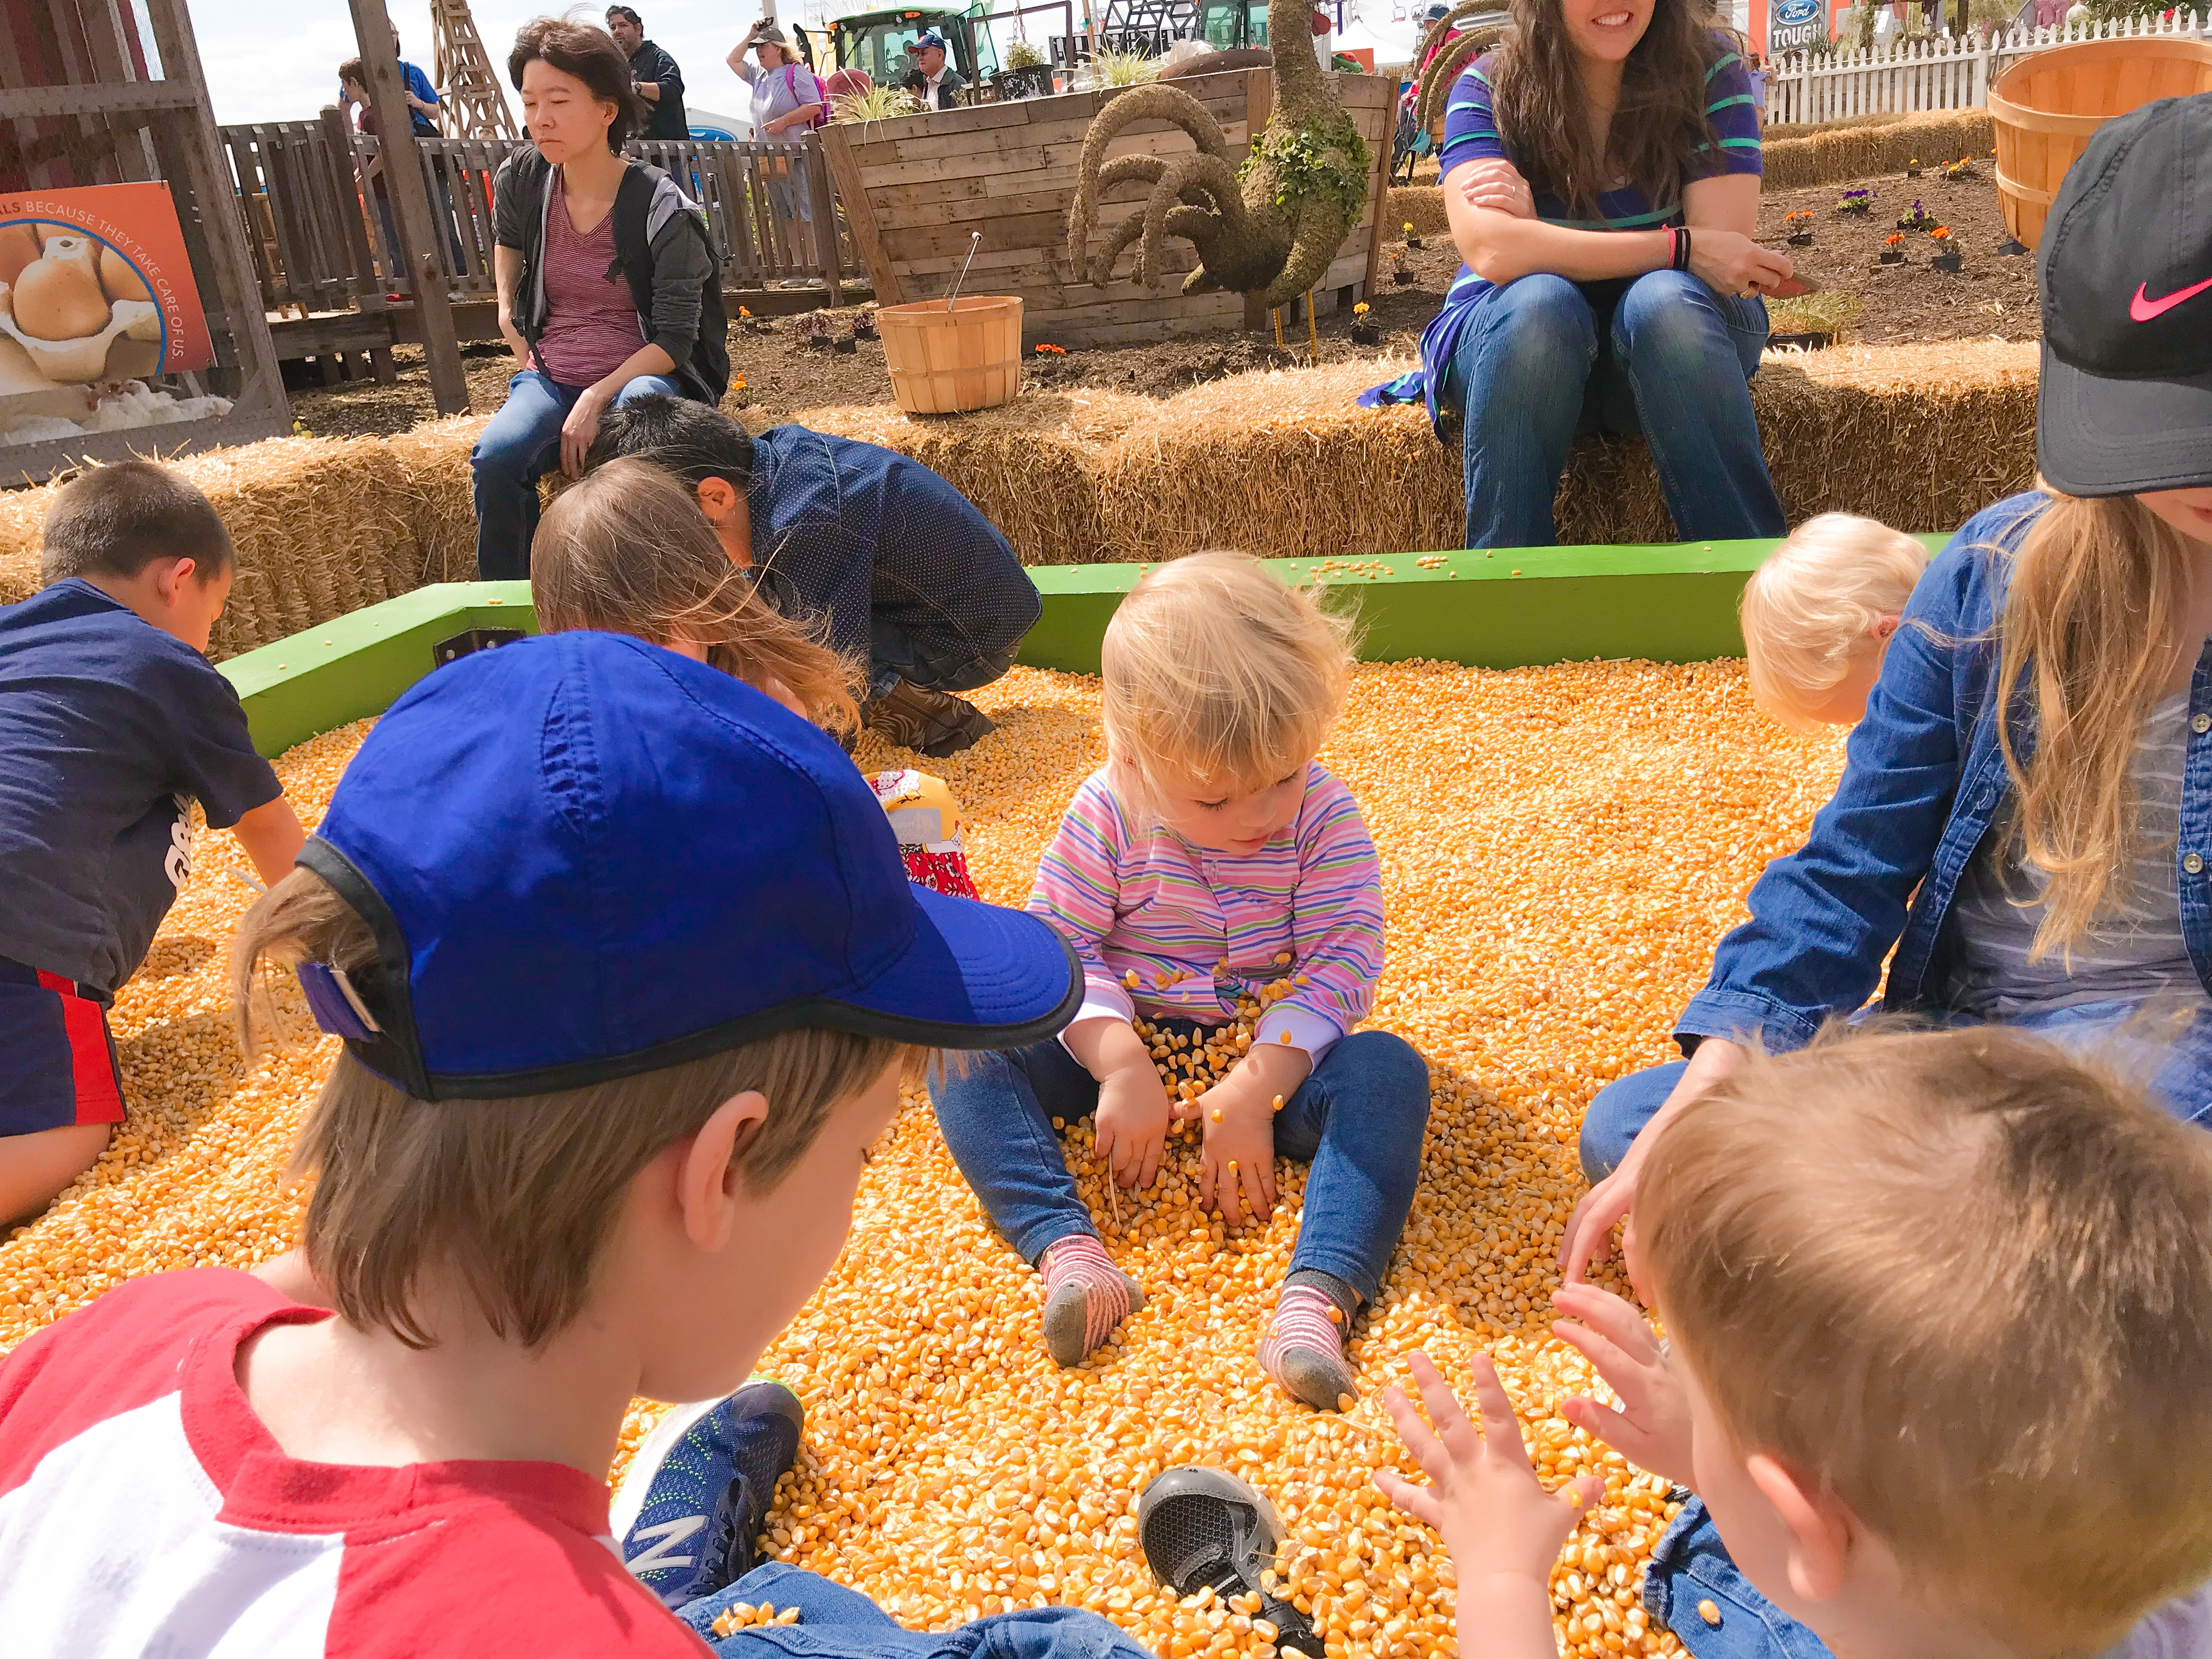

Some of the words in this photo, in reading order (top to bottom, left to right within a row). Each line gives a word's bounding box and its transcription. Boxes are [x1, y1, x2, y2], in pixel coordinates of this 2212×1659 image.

[1785, 3, 1810, 19] Ford
[1773, 23, 1821, 48] TOUGH
[1383, 65, 1412, 77] PAINT
[26, 201, 95, 225] BECAUSE
[99, 219, 133, 246] THEY
[133, 245, 161, 276] TAKE
[157, 278, 179, 313] CARE
[171, 317, 184, 335] OF
[171, 339, 184, 359] US.
[625, 1515, 709, 1575] N
